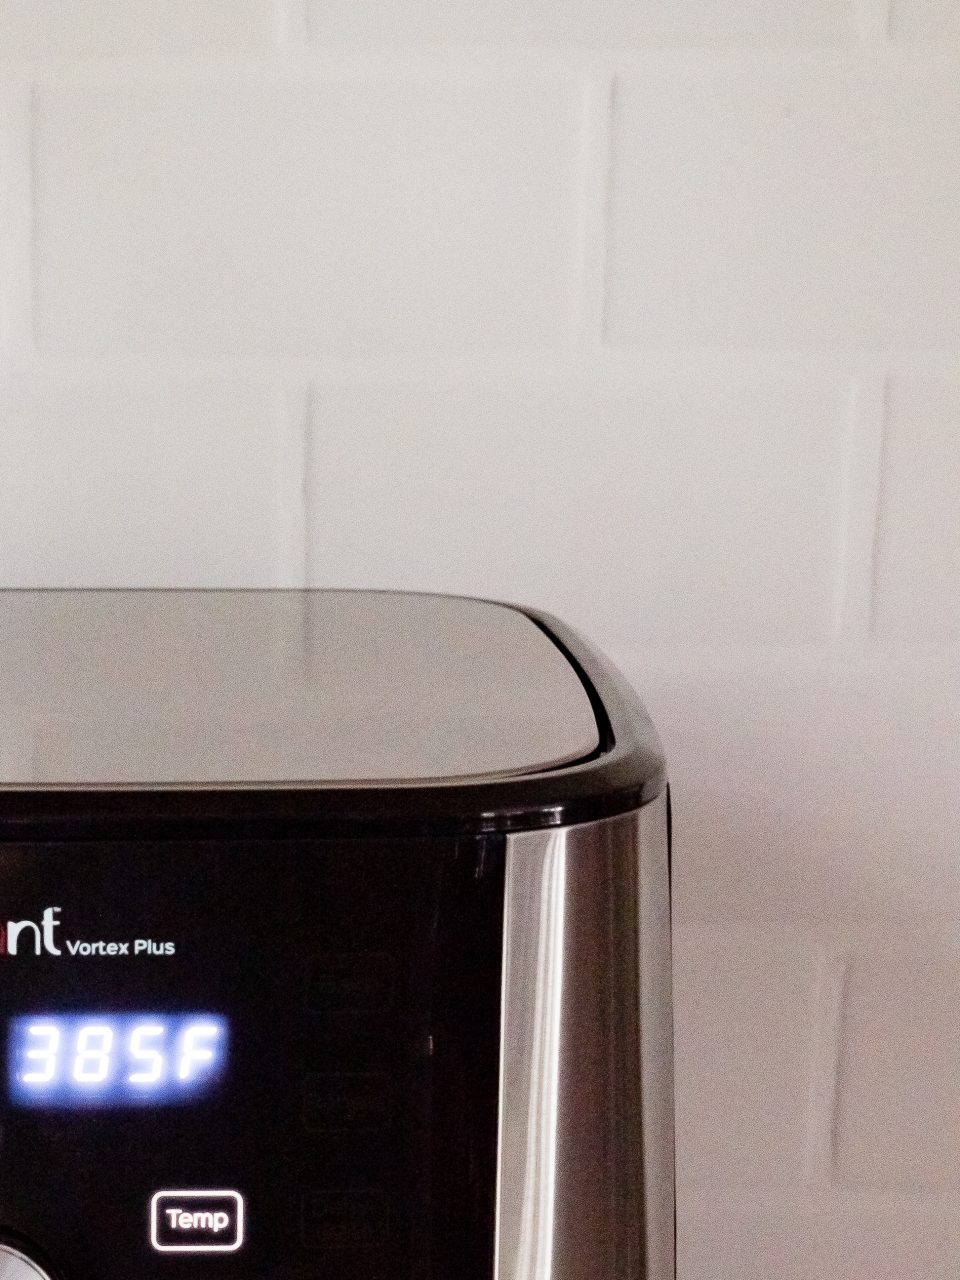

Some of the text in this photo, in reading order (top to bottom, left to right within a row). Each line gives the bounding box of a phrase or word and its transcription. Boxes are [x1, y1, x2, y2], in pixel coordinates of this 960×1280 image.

[66, 939, 175, 955] Vortex Plus
[22, 1024, 218, 1084] 385F
[166, 1207, 230, 1233] Temp
